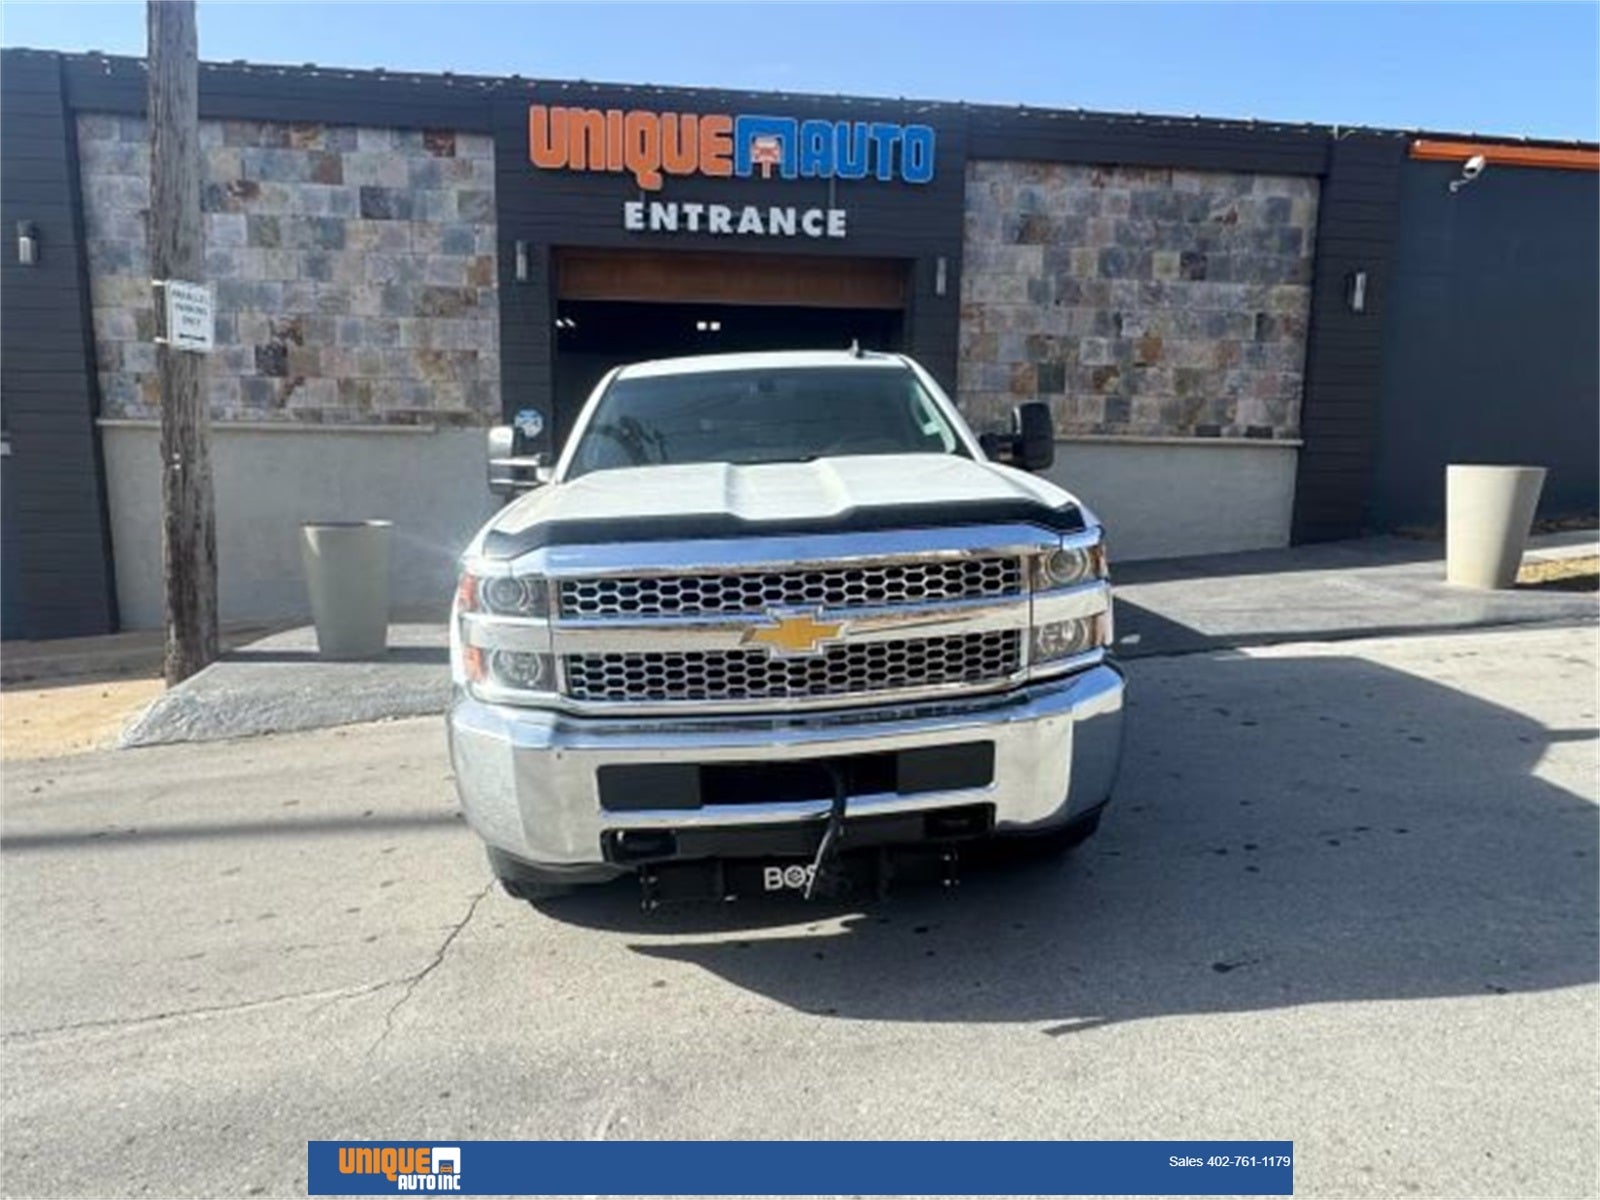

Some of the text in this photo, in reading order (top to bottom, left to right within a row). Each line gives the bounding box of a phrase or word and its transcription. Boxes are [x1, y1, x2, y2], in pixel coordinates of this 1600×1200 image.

[529, 105, 935, 191] UNIQUE AUTO
[624, 201, 848, 238] ENTRANCE
